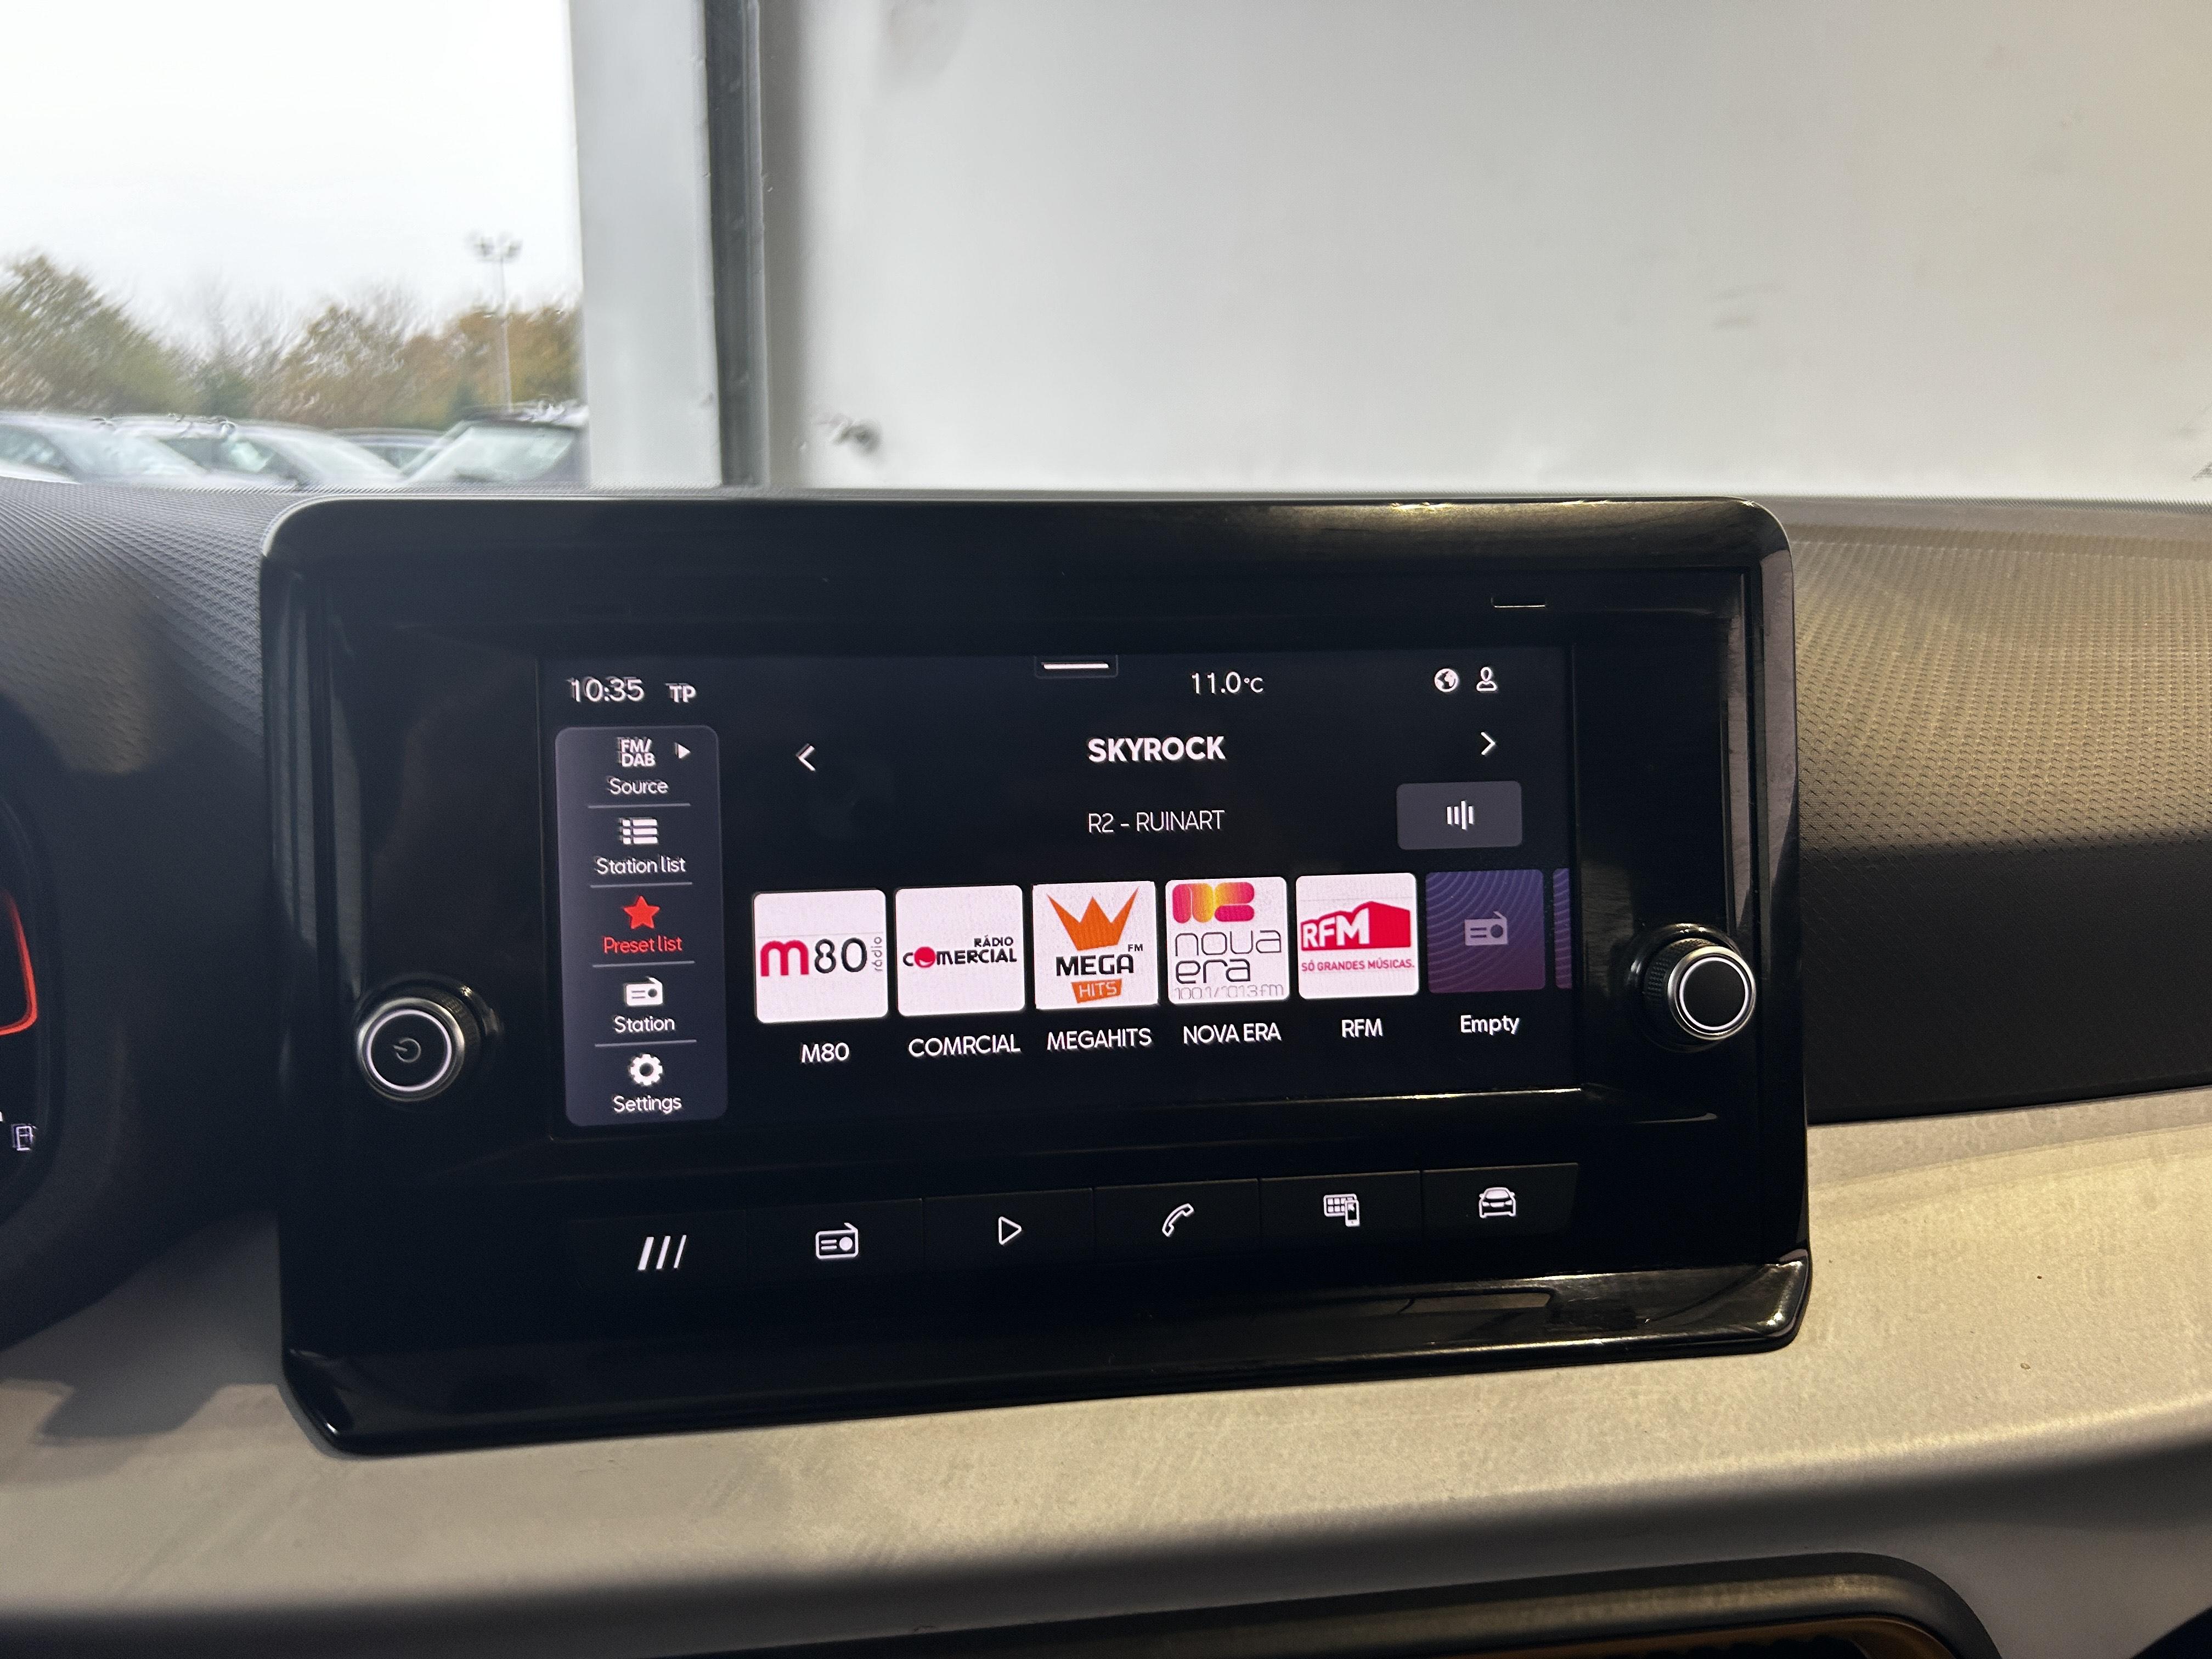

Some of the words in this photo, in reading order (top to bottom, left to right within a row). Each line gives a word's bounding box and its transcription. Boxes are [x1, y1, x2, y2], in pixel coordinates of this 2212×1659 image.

[568, 676, 645, 703] 10:35
[665, 683, 697, 703] TP
[618, 737, 652, 753] FM/
[1088, 736, 1227, 763] SKYROCK
[618, 752, 656, 768] DAB
[607, 776, 669, 795] Source
[1088, 813, 1114, 833] R2
[1136, 810, 1225, 832] RUINART
[595, 856, 657, 875] Station
[658, 855, 686, 873] list
[1302, 908, 1370, 949] RFM
[602, 936, 654, 954] Preset
[657, 935, 684, 951] list
[974, 935, 1014, 947] RÁDIO
[1128, 944, 1143, 952] FM
[760, 937, 868, 977] m80
[1056, 953, 1135, 977] MEGA
[1301, 960, 1315, 972] SÓ
[1317, 961, 1365, 971] GRANDES
[1176, 958, 1251, 984] era
[1079, 981, 1117, 998] HITS
[614, 1016, 675, 1034] Station
[1183, 1024, 1239, 1045] NOVA
[1243, 1022, 1282, 1042] ERA
[1341, 1018, 1384, 1038] RFM
[1460, 1014, 1520, 1036] Empty
[909, 1034, 1021, 1057] COMRCIAL
[1047, 1028, 1153, 1050] MEGAHITS
[801, 1042, 850, 1063] M80
[613, 1095, 682, 1115] Settings
